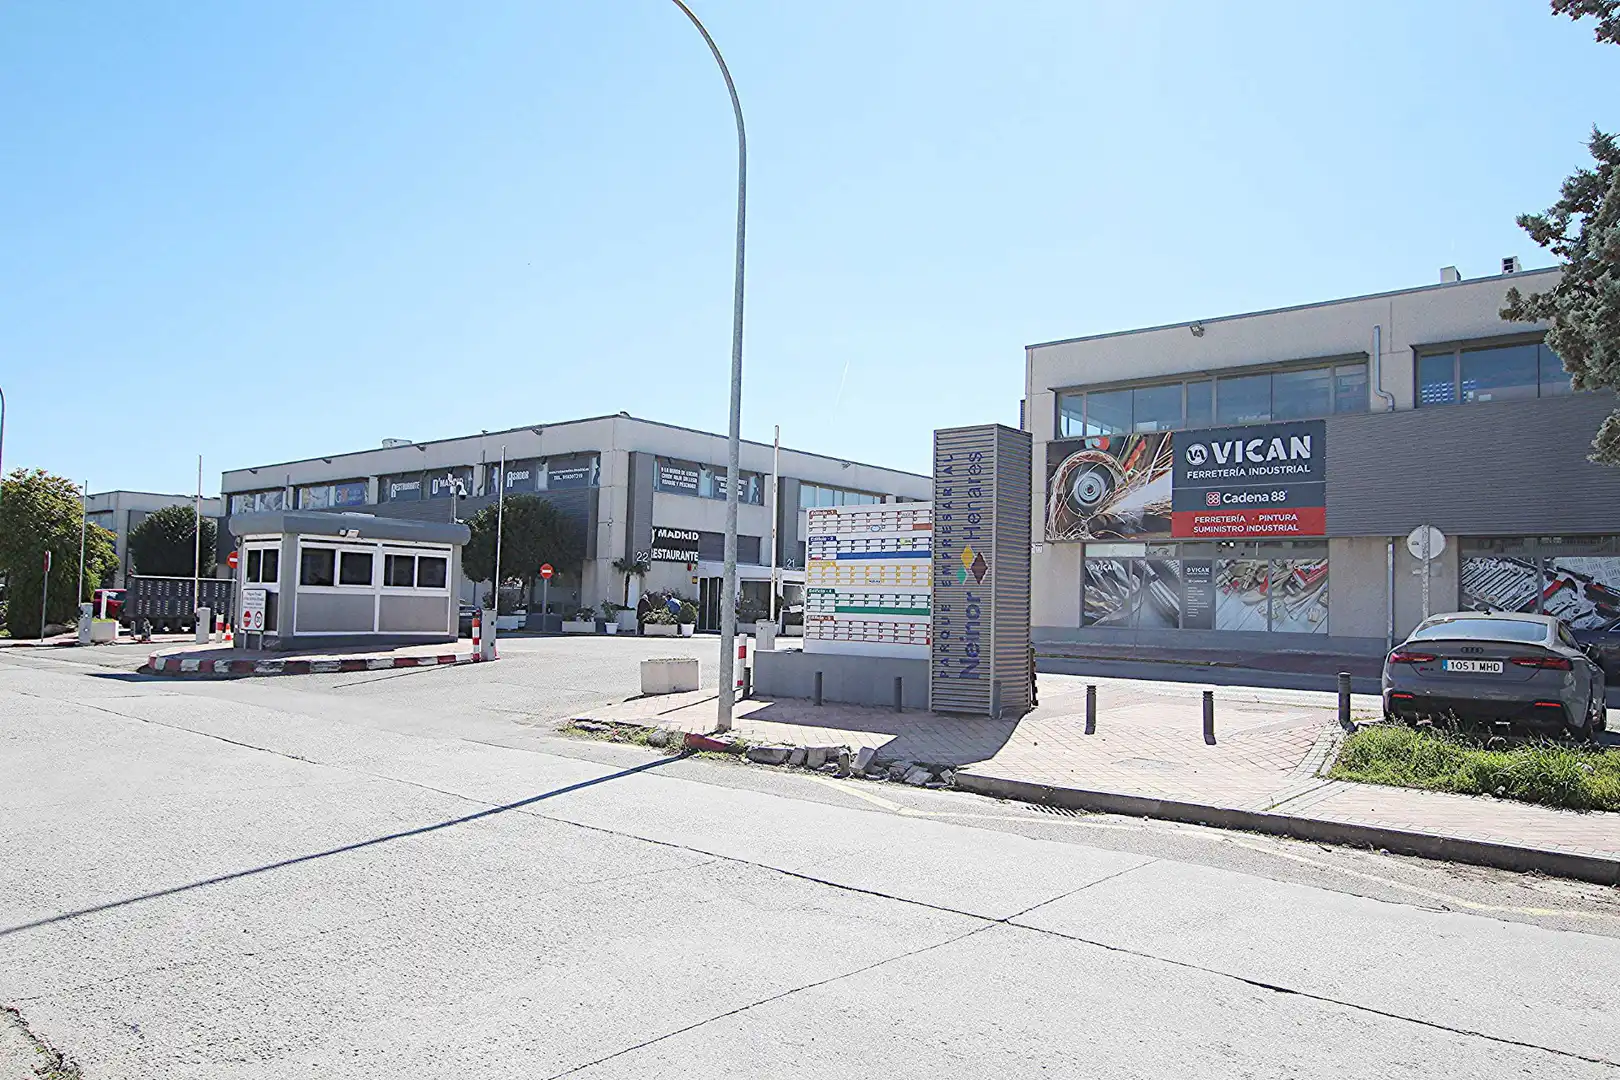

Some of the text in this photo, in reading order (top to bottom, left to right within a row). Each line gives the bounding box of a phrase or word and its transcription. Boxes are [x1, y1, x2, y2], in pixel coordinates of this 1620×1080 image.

[1211, 435, 1311, 465] VICAN
[1186, 465, 1311, 479] FERRETERÍA INDUSTRIAL
[1222, 493, 1269, 504] Cadena
[1194, 513, 1298, 524] FERRETERÍA PINTURA
[1193, 523, 1299, 533] SUMINISTRO INDUSTRIAL
[636, 551, 648, 563] 22
[786, 559, 795, 568] 21
[940, 453, 953, 678] PARQUE EMPRESARIAL
[959, 452, 984, 679] Neinor Henares
[1451, 662, 1501, 672] 1051 MHD
